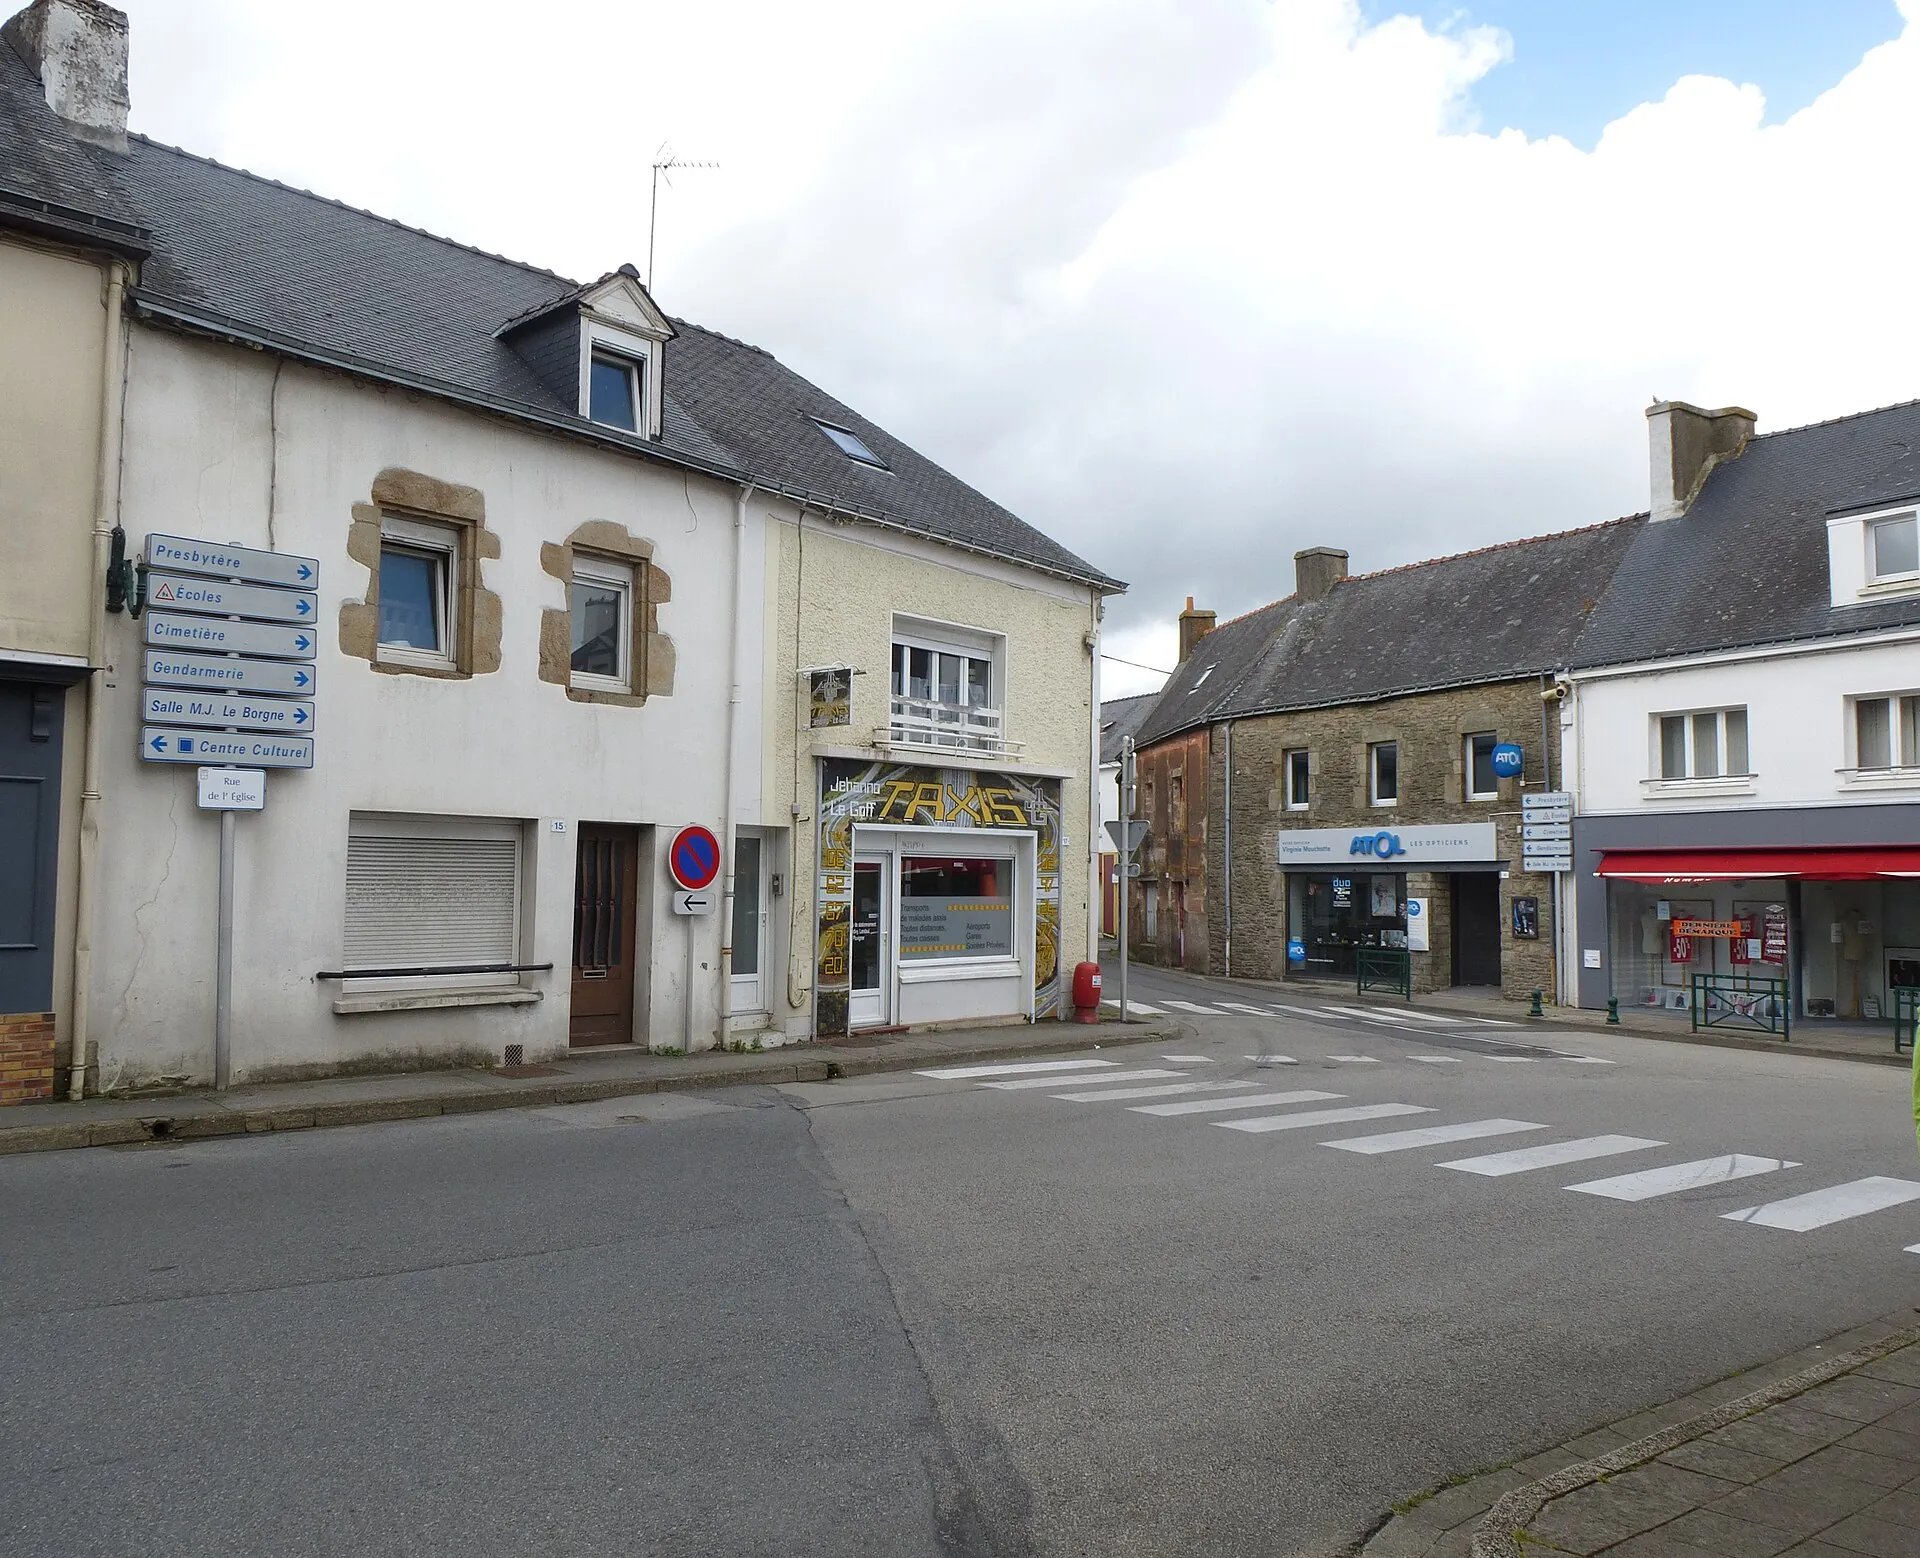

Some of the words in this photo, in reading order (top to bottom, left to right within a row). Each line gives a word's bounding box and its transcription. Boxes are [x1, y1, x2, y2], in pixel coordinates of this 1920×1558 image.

[156, 544, 241, 568] Presbytère
[176, 584, 222, 603] Écoles
[154, 623, 225, 641] Cimetière
[153, 661, 244, 680] Gendarmerie
[151, 700, 183, 713] Salle
[189, 703, 215, 716] M.J.
[223, 705, 236, 717] Le
[242, 706, 284, 722] Borgne
[200, 741, 246, 754] Centre
[252, 744, 308, 758] Culturel
[1495, 751, 1521, 766] ATOL
[224, 777, 241, 786] Rue
[208, 791, 219, 800] de
[878, 780, 1028, 825] TAXIS
[830, 801, 845, 816] Le
[850, 801, 877, 818] Goff
[555, 822, 564, 830] 15
[1350, 831, 1406, 858] ATOL
[1425, 839, 1469, 847] OPTICIENS
[1333, 877, 1351, 887] duo
[825, 956, 843, 975] 20
